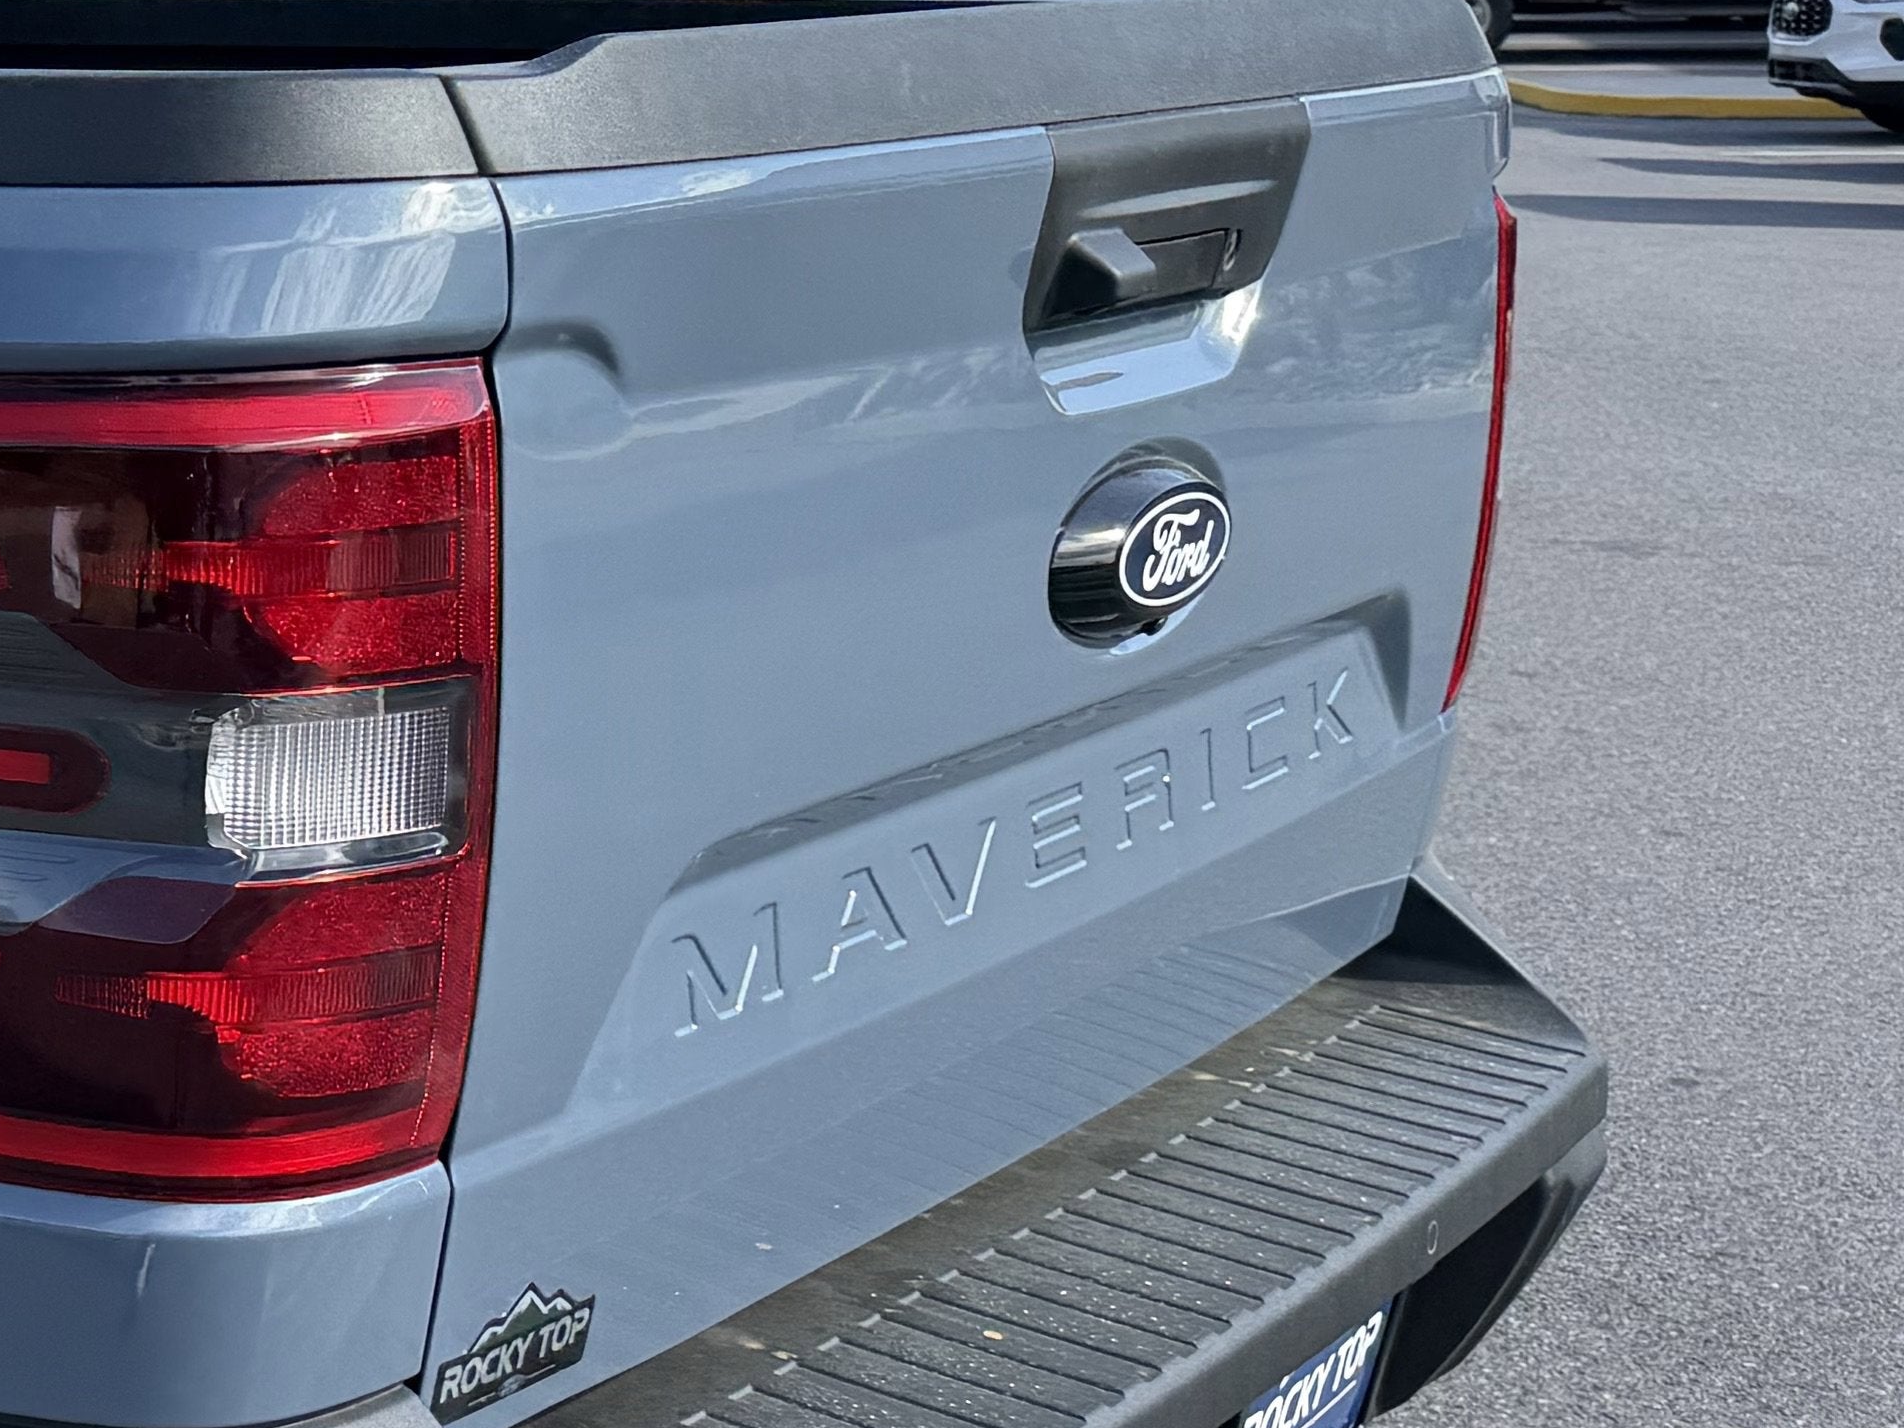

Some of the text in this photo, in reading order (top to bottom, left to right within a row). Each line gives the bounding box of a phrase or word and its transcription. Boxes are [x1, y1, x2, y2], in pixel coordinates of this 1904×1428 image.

[1142, 508, 1215, 592] Ford
[671, 668, 1353, 1039] MAVERICK
[439, 1331, 535, 1404] ROCKY
[538, 1307, 590, 1359] TOP
[1331, 1310, 1383, 1392] TOP
